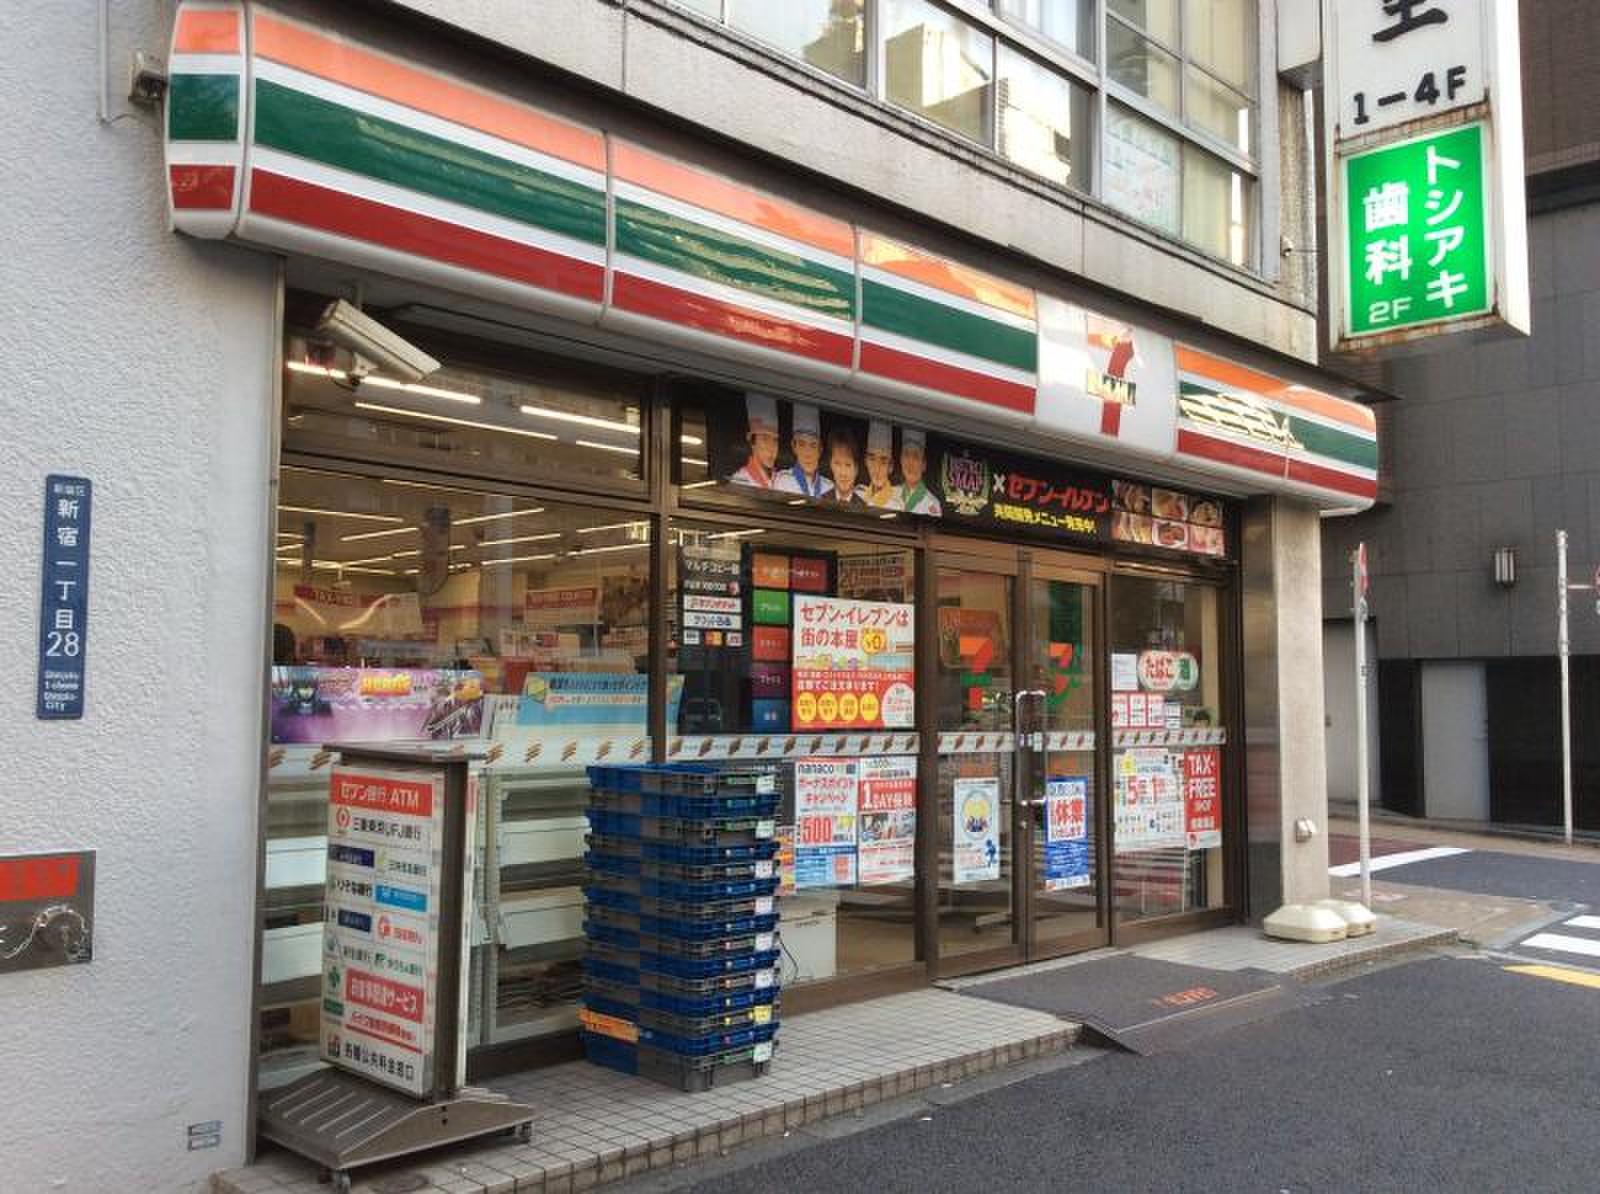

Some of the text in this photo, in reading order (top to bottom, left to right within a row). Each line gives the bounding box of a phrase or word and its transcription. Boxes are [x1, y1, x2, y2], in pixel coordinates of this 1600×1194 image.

[1362, 181, 1413, 286] 歯科
[1423, 144, 1469, 309] トシアキ
[1368, 295, 1412, 324] 2F
[45, 631, 80, 657] 28
[389, 786, 420, 810] ATM
[801, 815, 832, 843] 500
